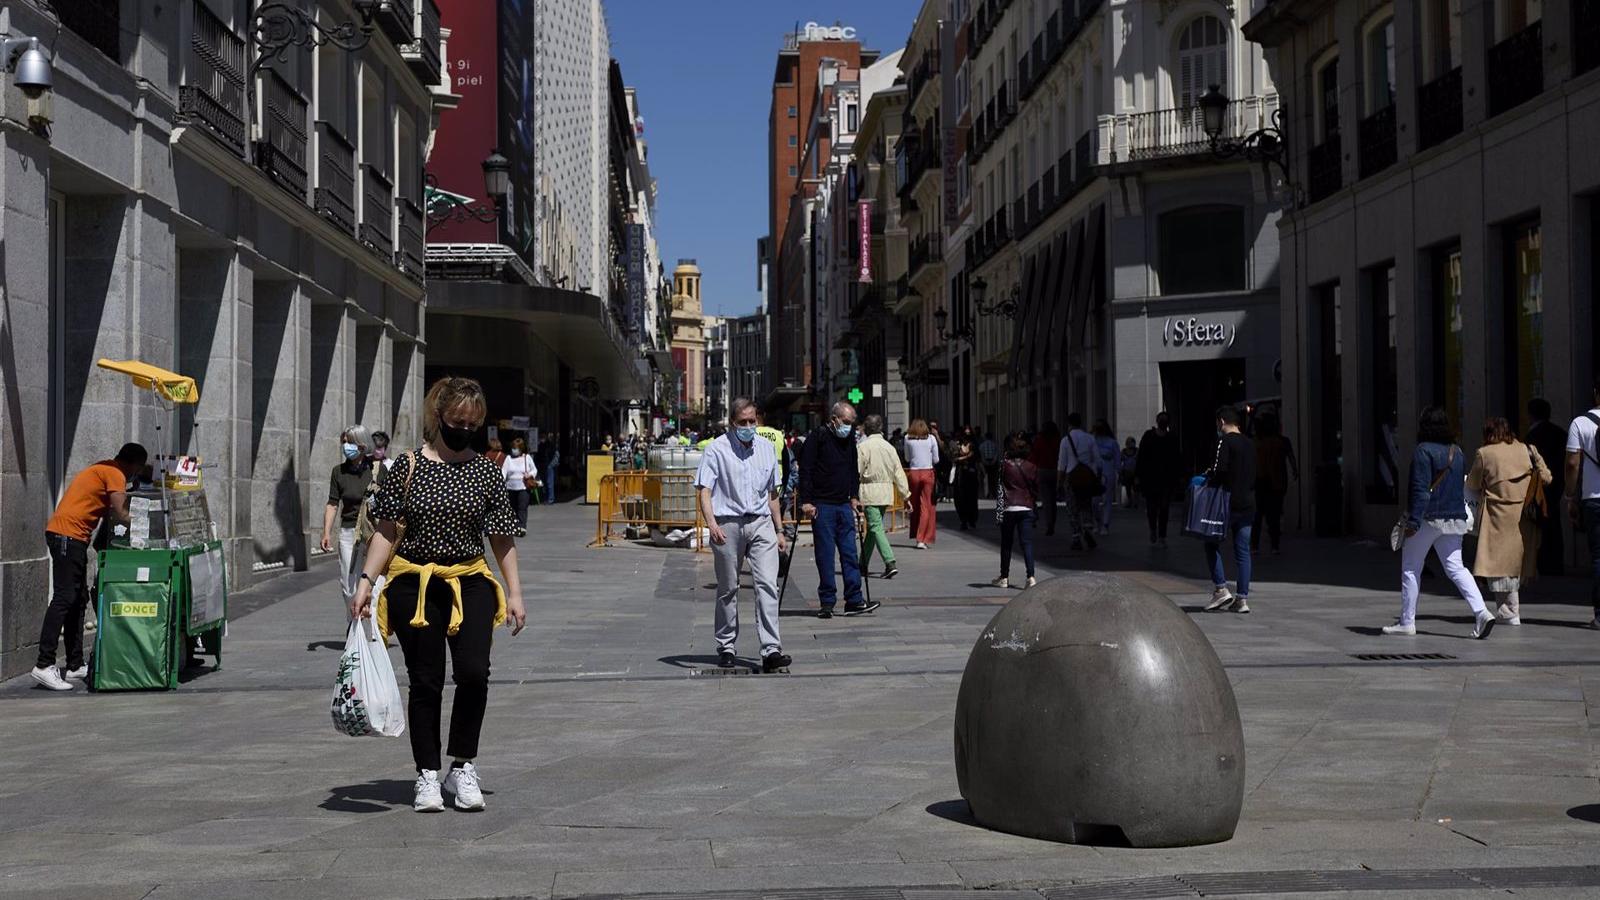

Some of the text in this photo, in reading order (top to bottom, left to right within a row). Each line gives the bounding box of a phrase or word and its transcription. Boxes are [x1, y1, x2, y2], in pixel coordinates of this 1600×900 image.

[804, 21, 857, 40] fnac
[457, 75, 482, 87] piel
[122, 604, 156, 614] ONCE
